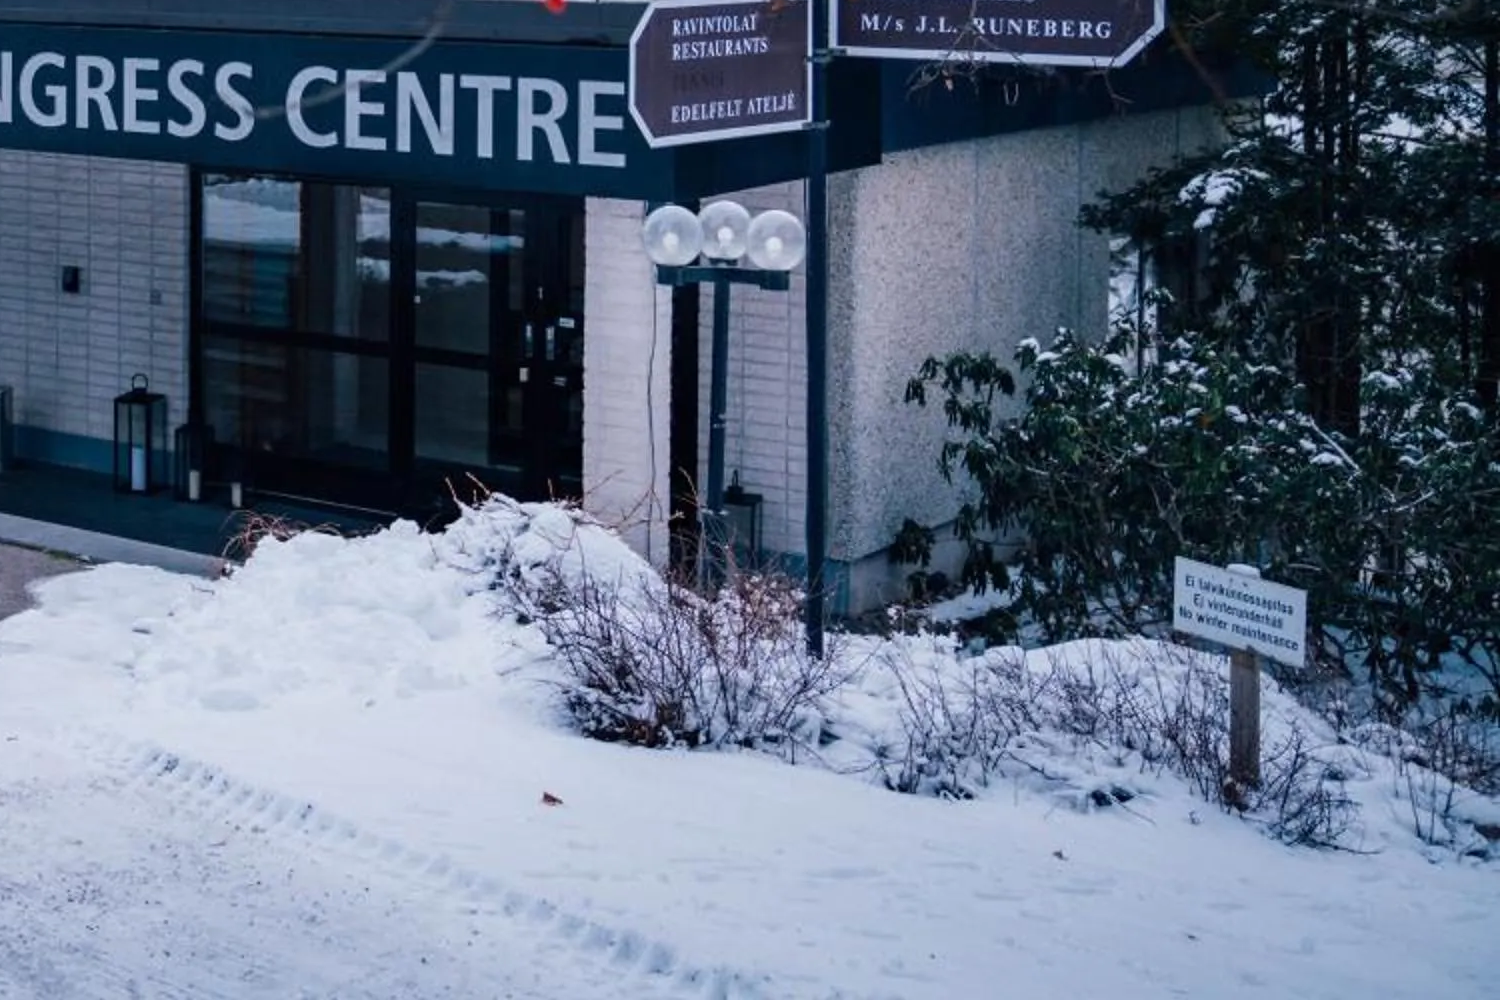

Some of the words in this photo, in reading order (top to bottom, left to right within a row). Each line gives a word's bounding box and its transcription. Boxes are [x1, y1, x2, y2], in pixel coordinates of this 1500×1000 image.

[672, 12, 759, 36] RAVINTOLAT
[915, 16, 958, 33] J.L.
[972, 16, 1112, 39] RUNEBERG
[672, 36, 769, 60] RESTAURANTS
[285, 65, 627, 168] CENTRE
[671, 99, 743, 123] EDELFELT
[1185, 575, 1195, 588] Ei
[1179, 605, 1192, 619] No
[1196, 611, 1227, 629] winter
